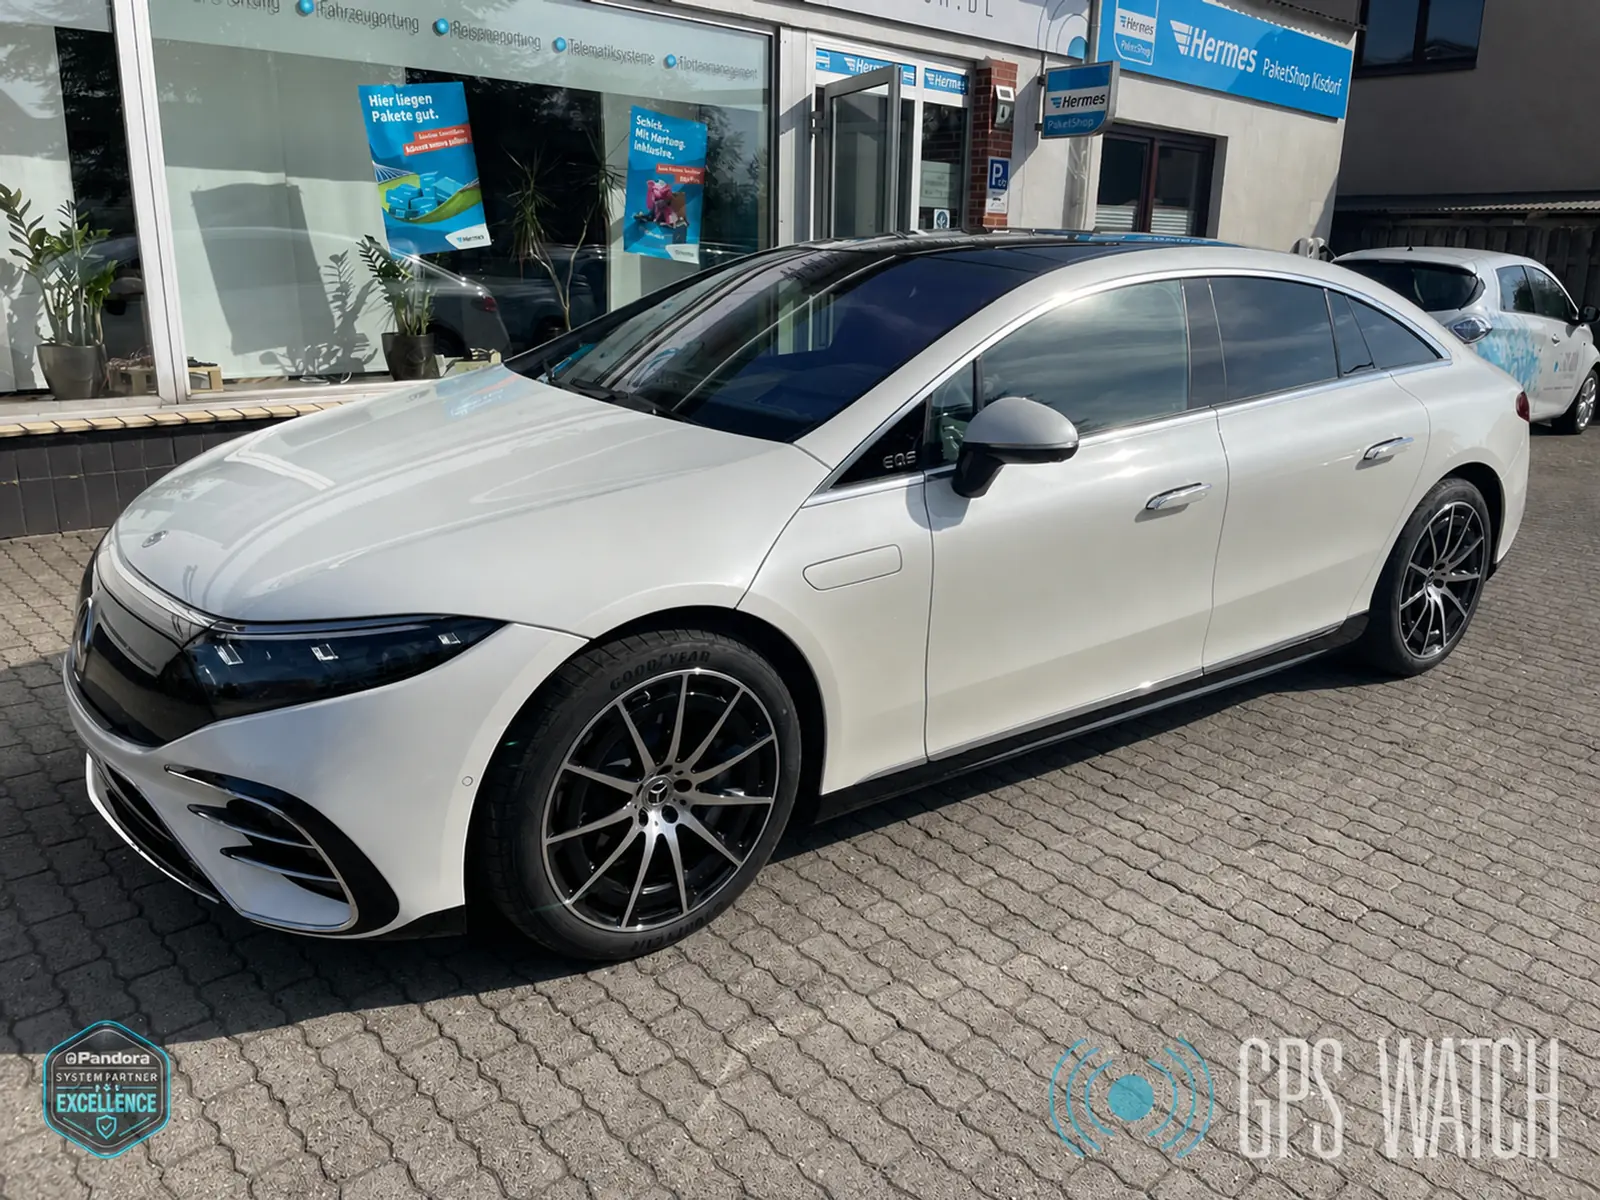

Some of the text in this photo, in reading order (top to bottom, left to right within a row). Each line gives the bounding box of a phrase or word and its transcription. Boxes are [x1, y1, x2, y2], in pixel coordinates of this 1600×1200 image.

[317, 0, 419, 34] Fahrzeugortung
[568, 38, 655, 66] Telematiksysteme
[1190, 27, 1343, 95] Hermes PaketShop Kisdorf
[368, 93, 433, 108] Hier liegen
[1062, 94, 1105, 108] Hermes
[371, 108, 439, 123] Pakete gut.
[635, 128, 649, 140] Mit
[883, 450, 916, 469] EQS
[610, 651, 711, 691] GOODYEAR
